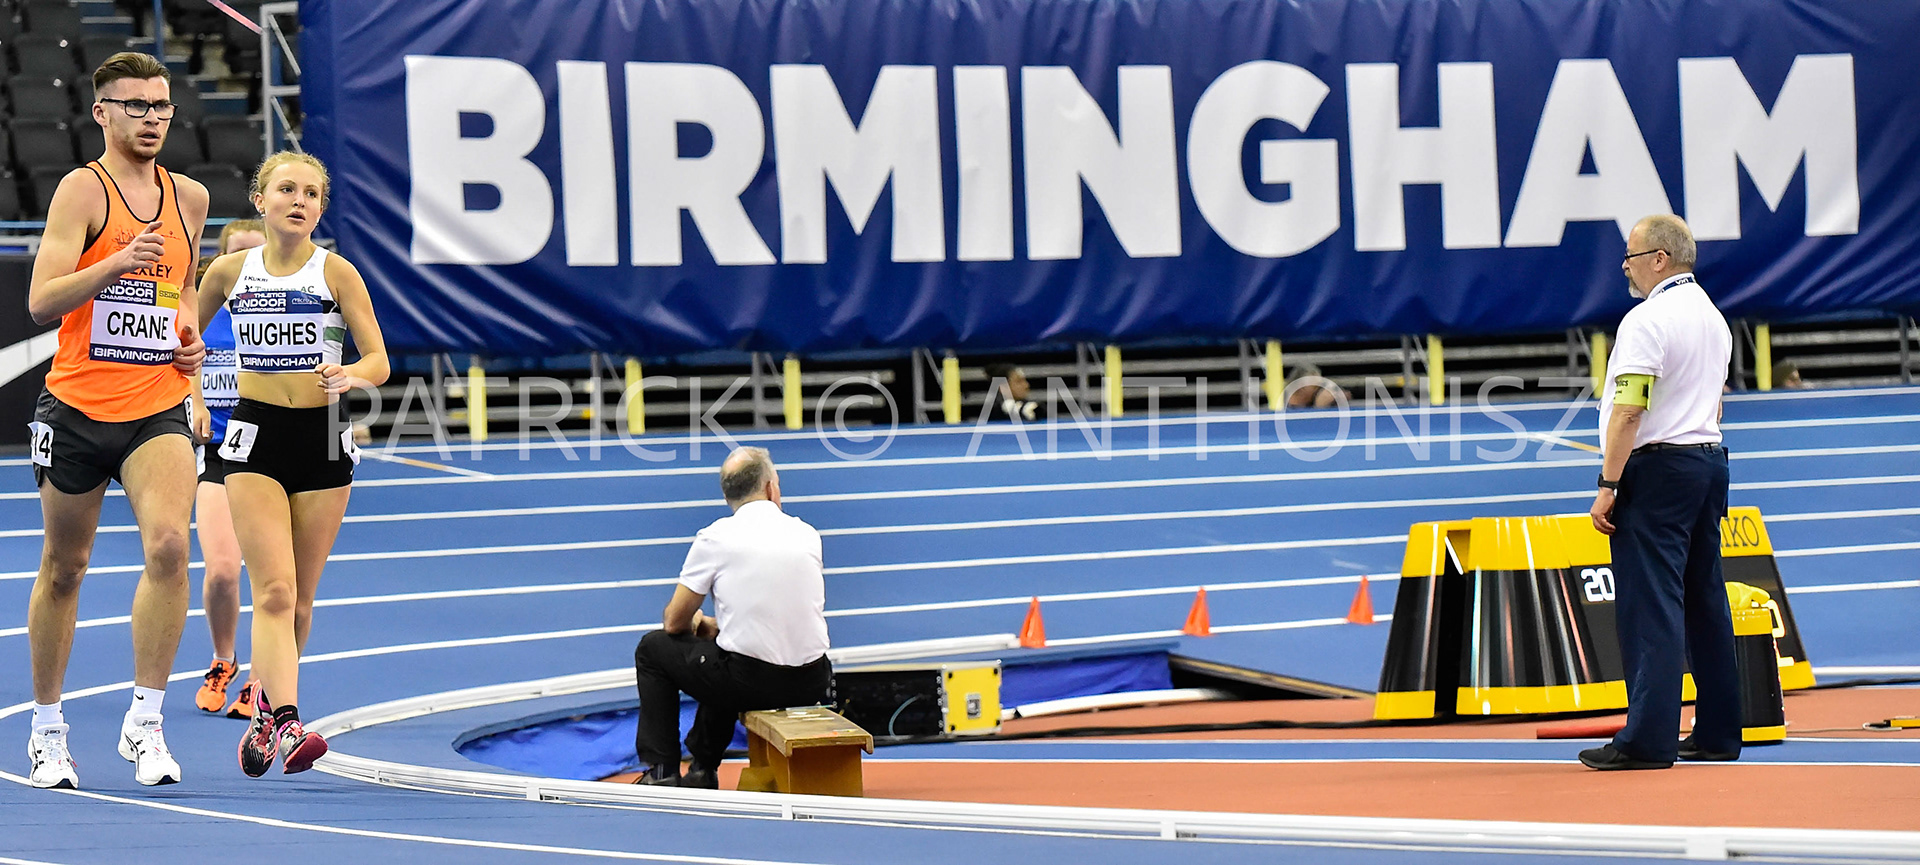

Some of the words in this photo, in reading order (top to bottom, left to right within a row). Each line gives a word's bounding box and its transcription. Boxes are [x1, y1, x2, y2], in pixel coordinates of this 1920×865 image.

[405, 53, 1861, 266] BIRMINGHAM
[130, 264, 173, 278] XLEY
[100, 293, 153, 304] CHAMPIONSHIPS
[301, 285, 315, 294] AC
[238, 298, 287, 308] INDOOR
[106, 310, 169, 341] CRANE
[238, 321, 317, 346] HUGHES
[94, 347, 174, 362] BIRMINGHAM
[243, 356, 320, 368] BIRMINGHAM
[32, 428, 51, 459] 14
[228, 428, 243, 453] 4
[1720, 516, 1760, 548] IKO
